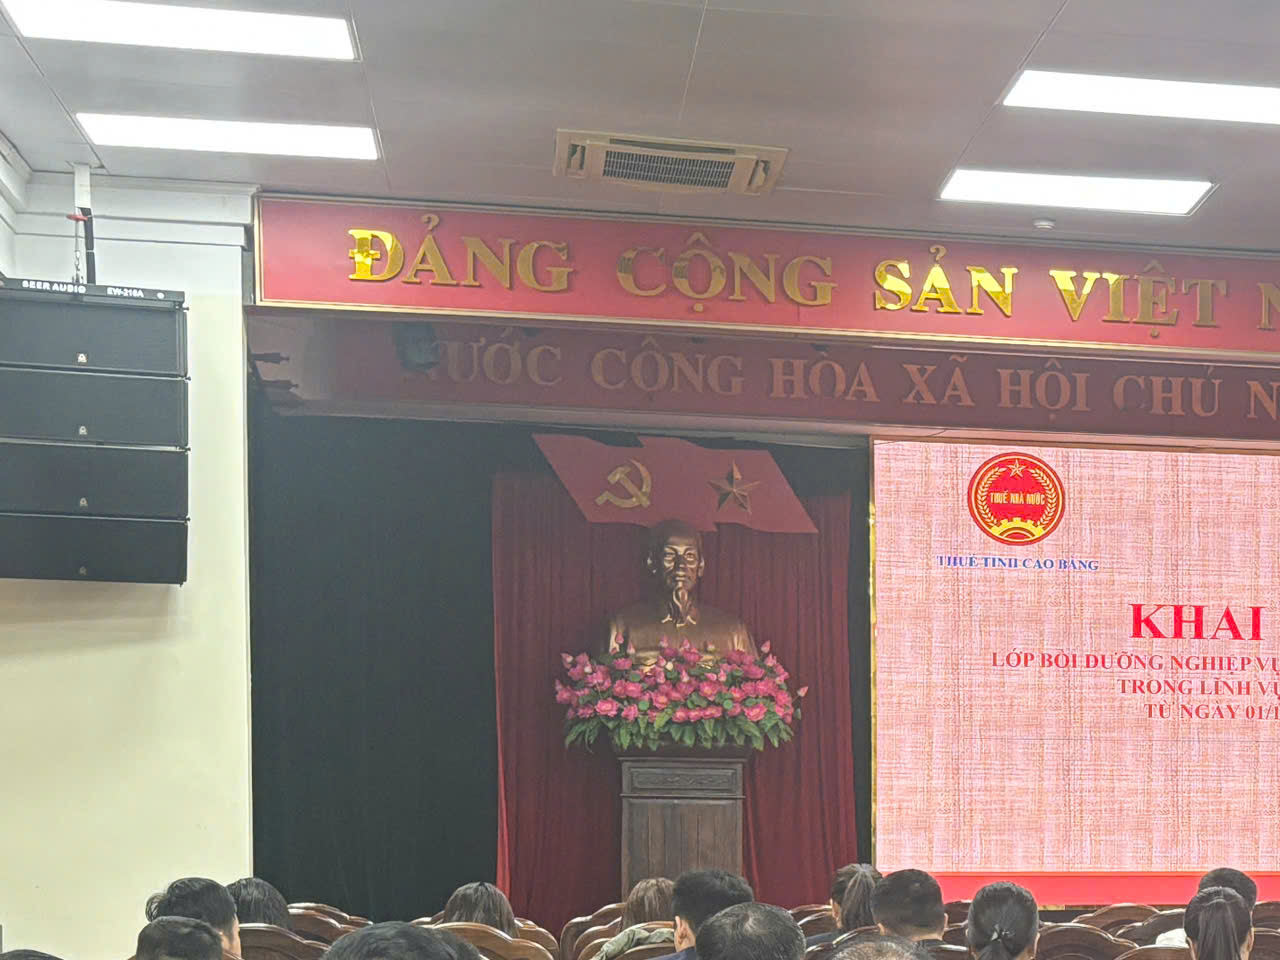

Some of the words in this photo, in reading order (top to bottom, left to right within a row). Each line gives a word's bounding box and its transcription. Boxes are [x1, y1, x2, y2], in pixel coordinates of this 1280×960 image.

[347, 214, 577, 293] ĐẢNG
[616, 231, 838, 313] CỘNG
[873, 244, 1020, 318] SẢN
[1049, 259, 1229, 338] VIỆT
[52, 283, 87, 294] AUDIO
[405, 326, 562, 385] ƯỚC
[767, 350, 881, 402] HÒA
[901, 354, 976, 407] XÃ
[997, 358, 1092, 422] HỘI
[1022, 558, 1055, 569] CAO
[1129, 603, 1266, 641] KHAI
[992, 647, 1035, 668] LỚP
[1085, 650, 1164, 670] DƯỠNG
[1170, 654, 1251, 675] NGHIỆP
[1117, 679, 1193, 695] TRONG
[1200, 677, 1251, 696] LĨNH
[1144, 700, 1175, 719] TỪ
[1180, 701, 1240, 719] NGÀY
